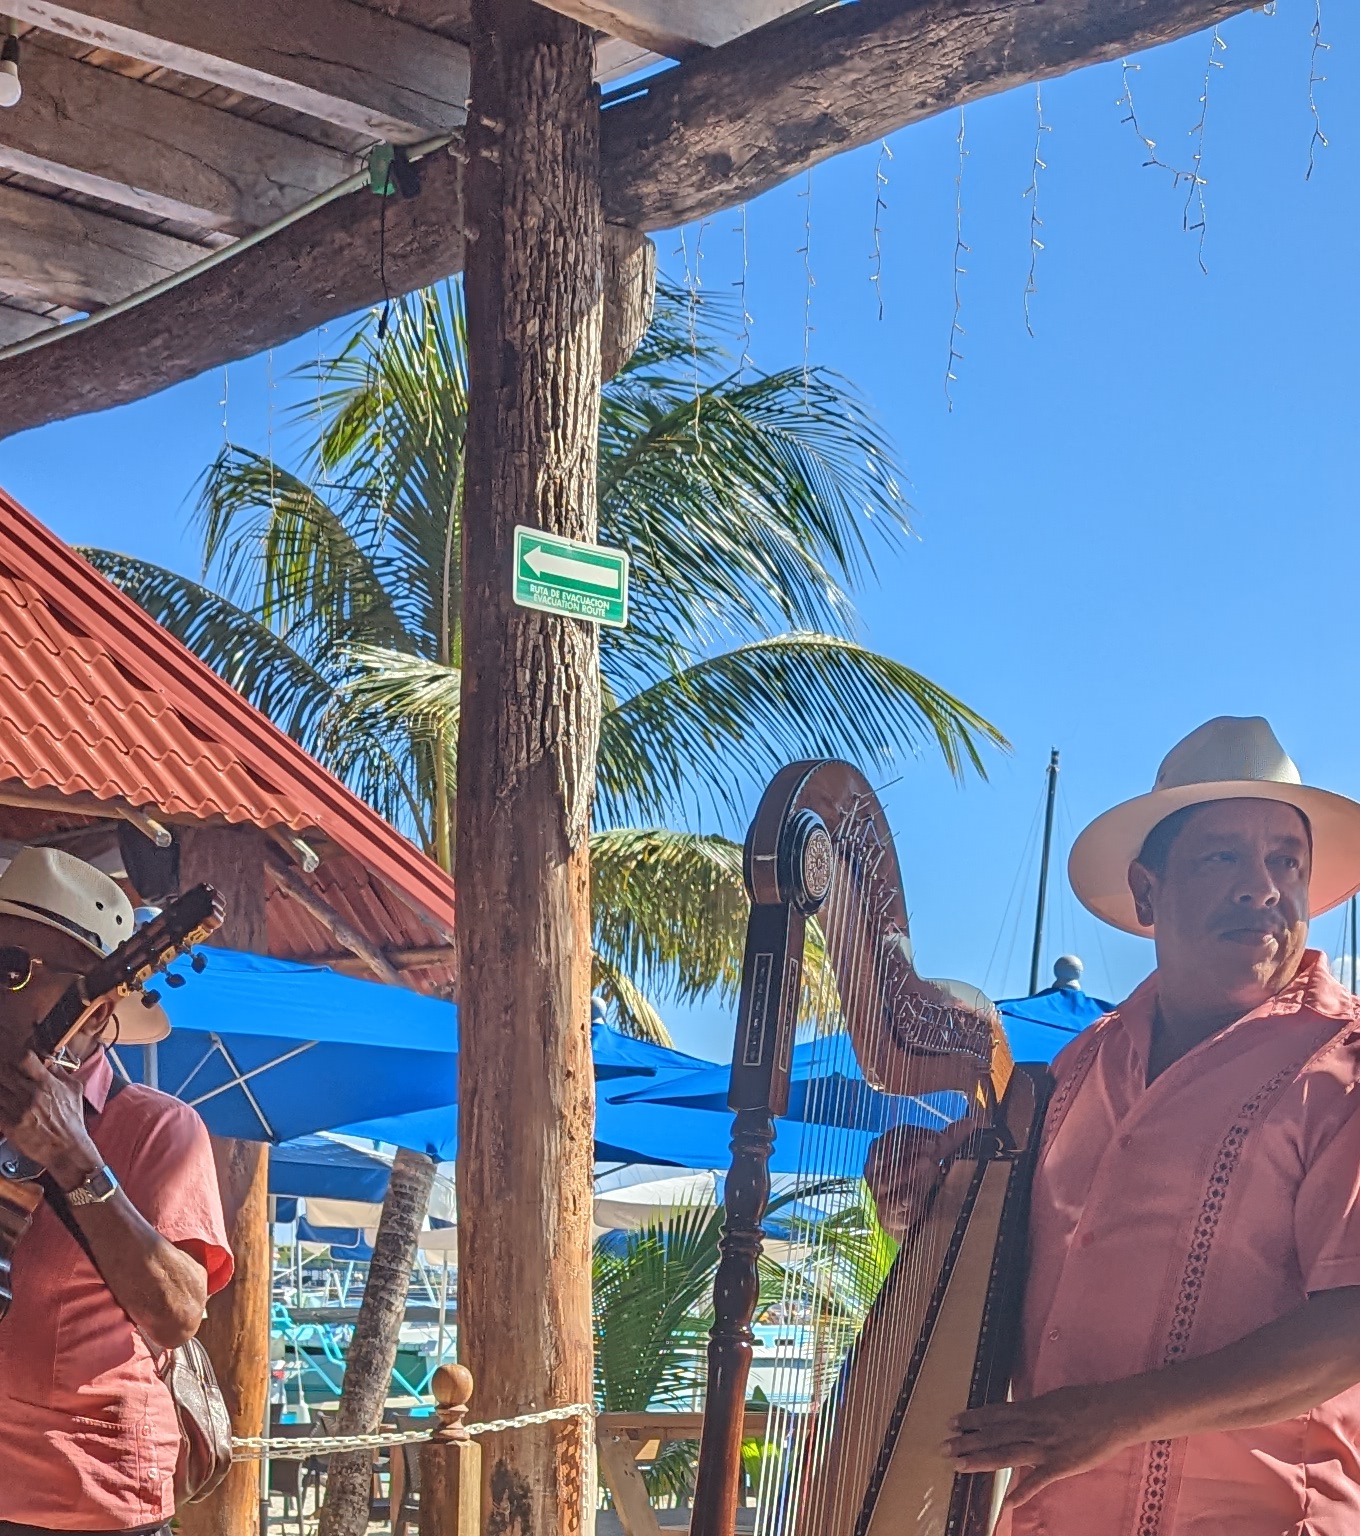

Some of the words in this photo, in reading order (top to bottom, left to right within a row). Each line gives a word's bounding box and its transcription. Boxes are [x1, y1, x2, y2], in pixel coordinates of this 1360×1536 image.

[529, 583, 549, 596] RUTA
[550, 588, 560, 599] DE
[533, 593, 580, 612] EVACUATION
[581, 604, 606, 617] ROUTE
